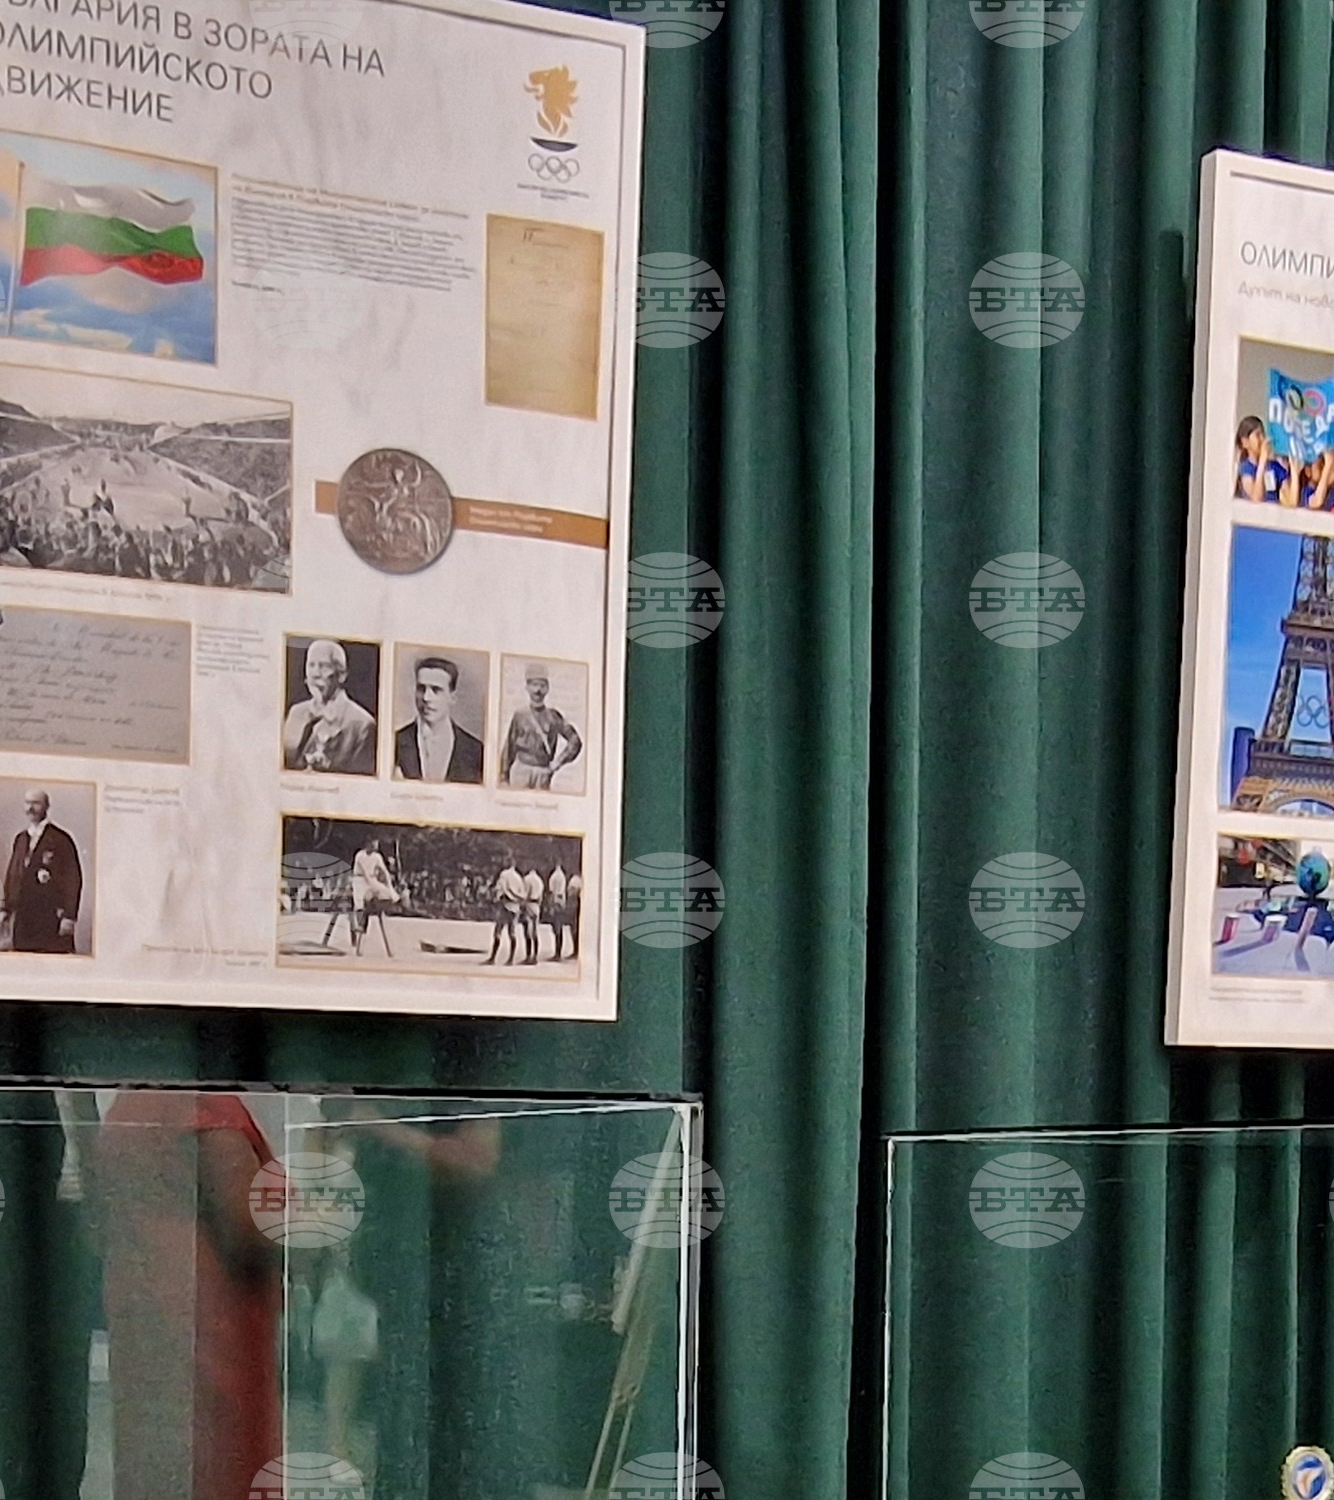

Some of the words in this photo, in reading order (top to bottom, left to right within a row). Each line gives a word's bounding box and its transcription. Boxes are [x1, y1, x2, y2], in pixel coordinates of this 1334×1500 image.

[173, 11, 193, 40] В
[203, 18, 332, 69] ЗОРАТА
[342, 44, 385, 77] НА
